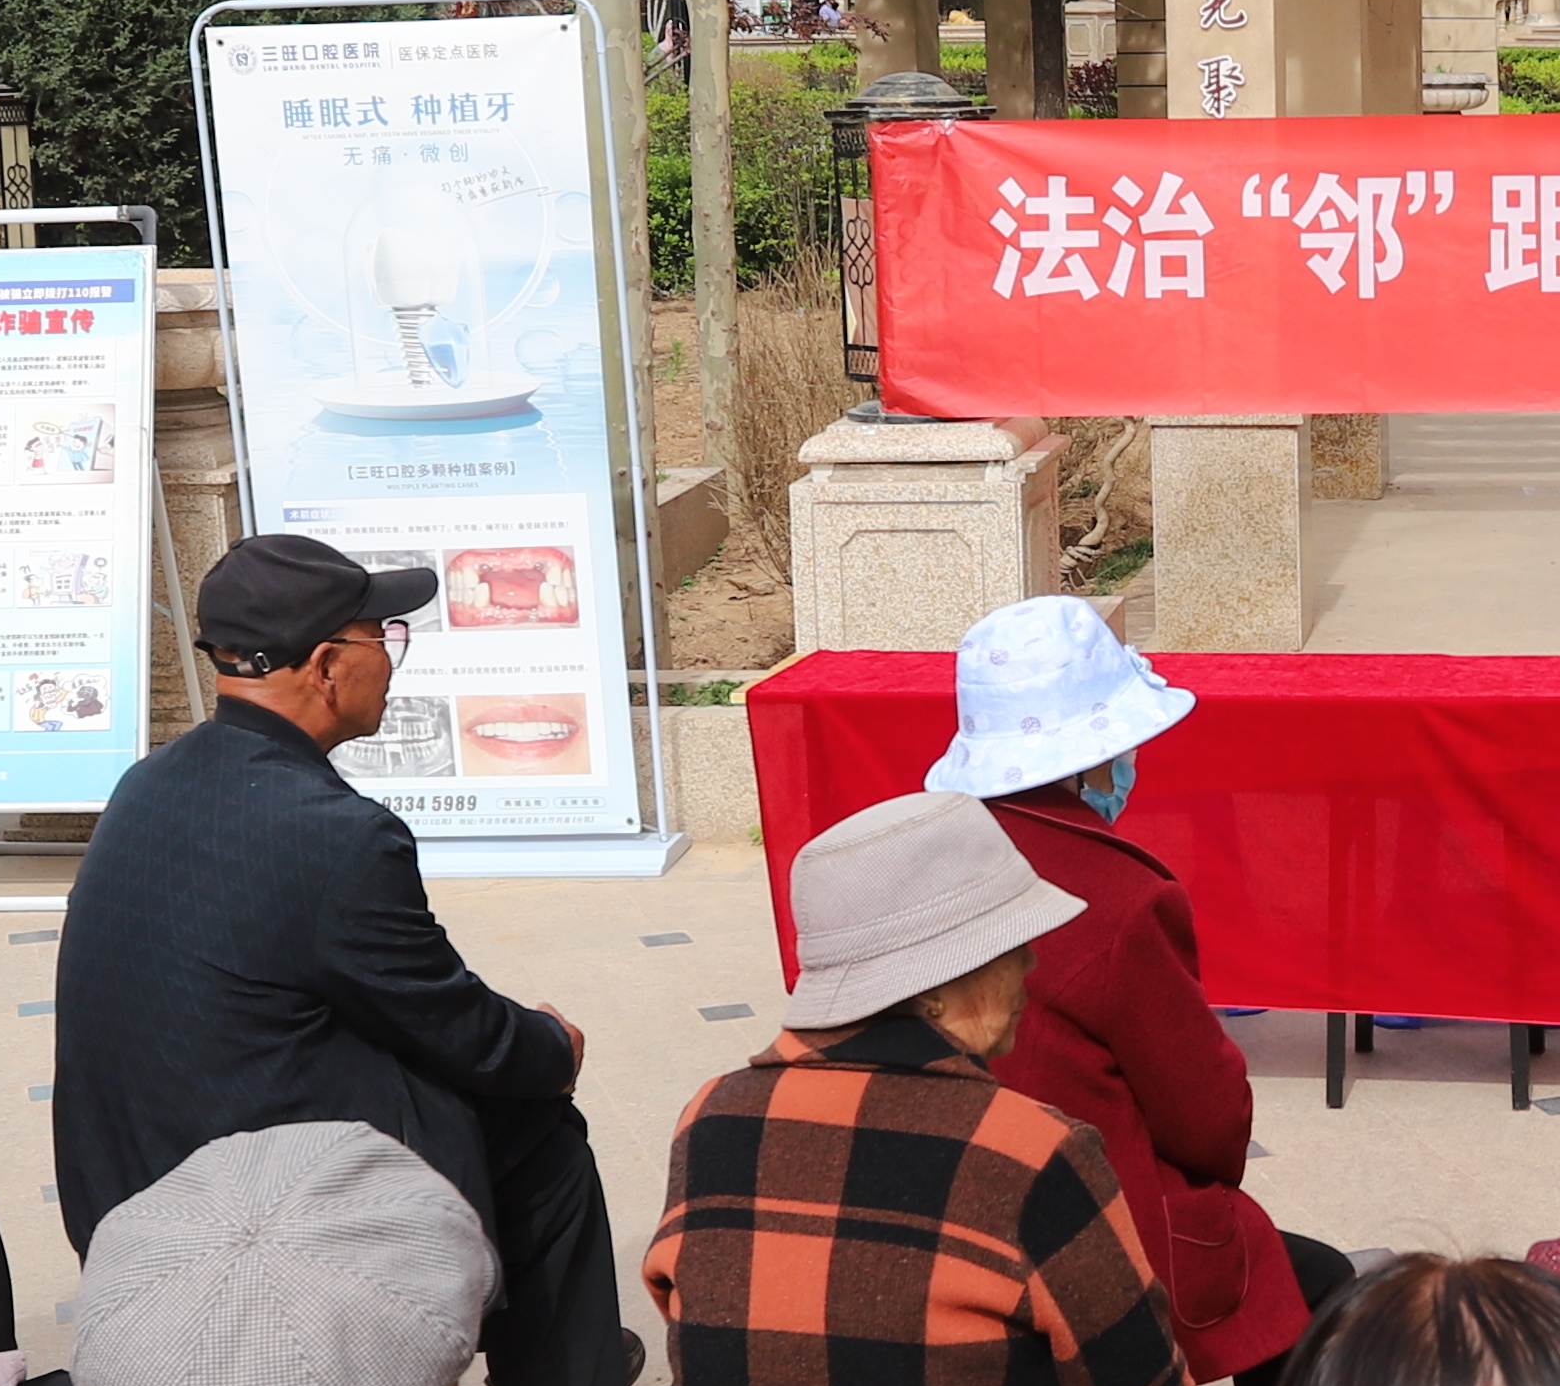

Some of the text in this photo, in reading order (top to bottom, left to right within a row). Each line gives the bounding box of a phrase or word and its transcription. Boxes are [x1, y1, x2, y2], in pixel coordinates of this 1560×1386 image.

[262, 42, 381, 62] 三旺口腔医院
[398, 43, 500, 63] 医保定点医院
[282, 91, 515, 129] 睡眠式 种植牙
[431, 795, 477, 811] 5989
